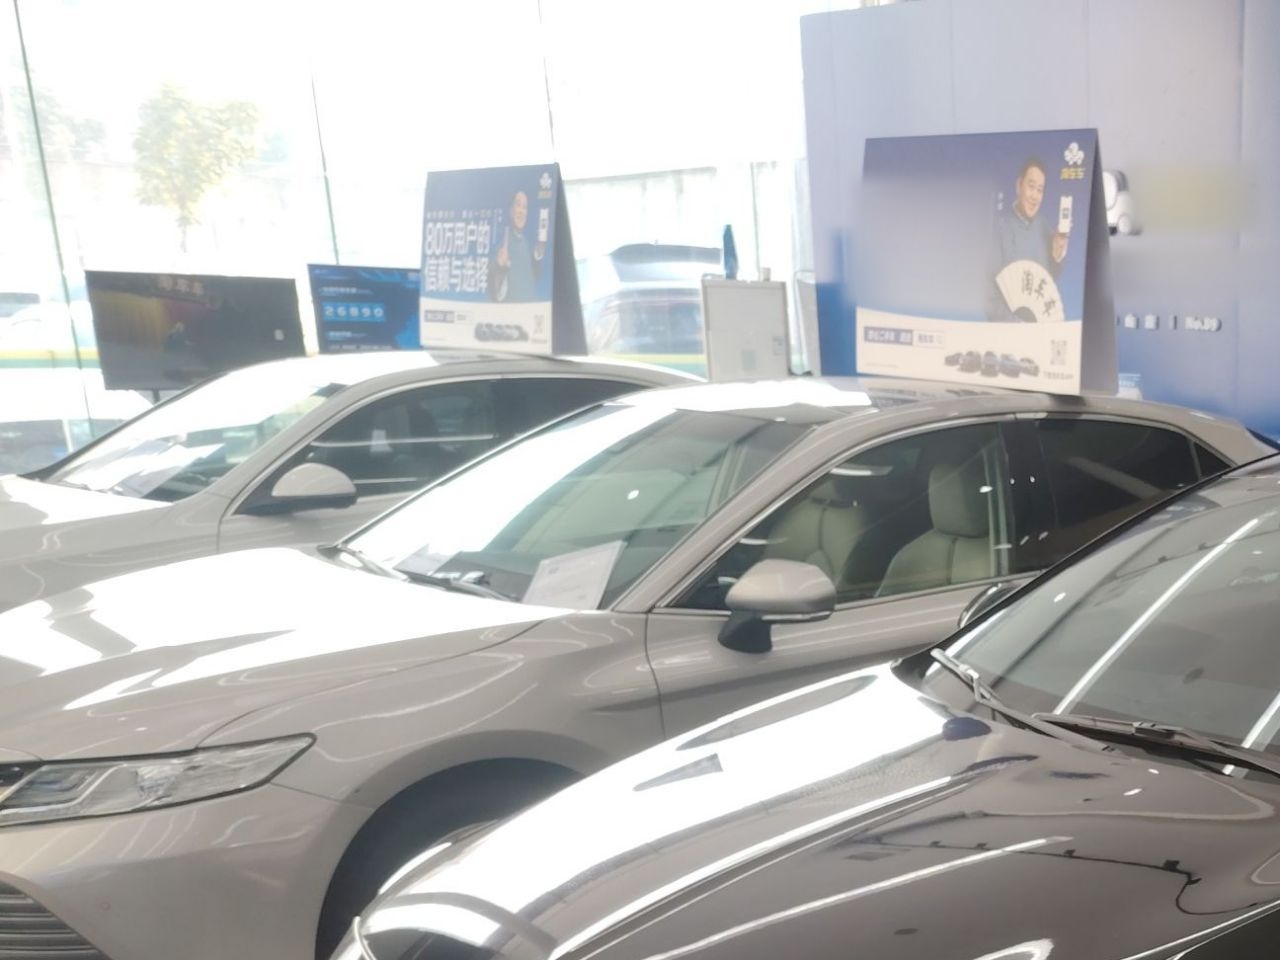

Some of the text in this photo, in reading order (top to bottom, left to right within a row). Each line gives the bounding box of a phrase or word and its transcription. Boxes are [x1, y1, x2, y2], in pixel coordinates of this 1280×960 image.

[425, 220, 491, 255] 80万用户的
[425, 256, 489, 294] 信赖与选择
